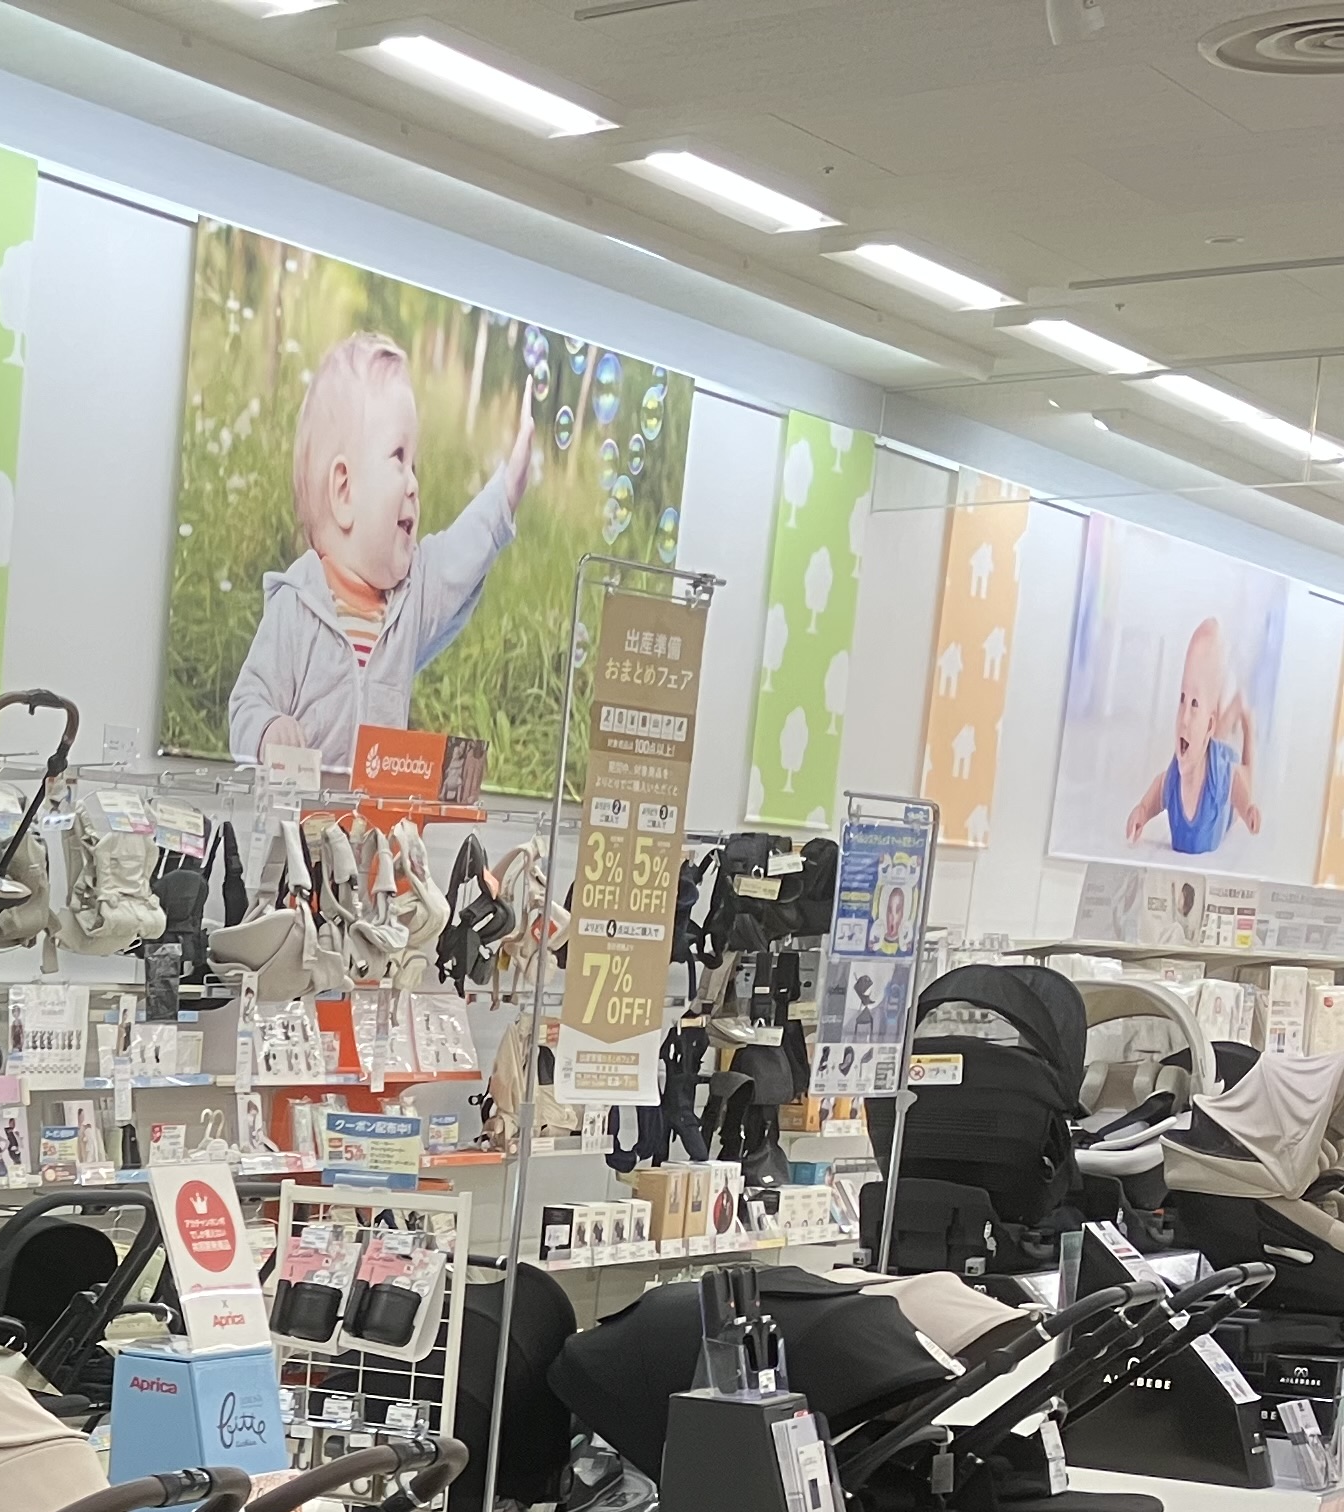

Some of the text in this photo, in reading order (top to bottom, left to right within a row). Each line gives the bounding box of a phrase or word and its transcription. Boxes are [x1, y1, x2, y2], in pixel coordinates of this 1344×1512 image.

[624, 628, 682, 662] 出産準備
[604, 656, 694, 692] おまとめフェア
[381, 753, 434, 780] ergobaby
[584, 831, 671, 888] 3% 5%
[582, 883, 667, 914] OFF! OFF!
[606, 996, 652, 1026] OFF!
[212, 1311, 246, 1330] Aprica
[129, 1376, 178, 1395] Aprica
